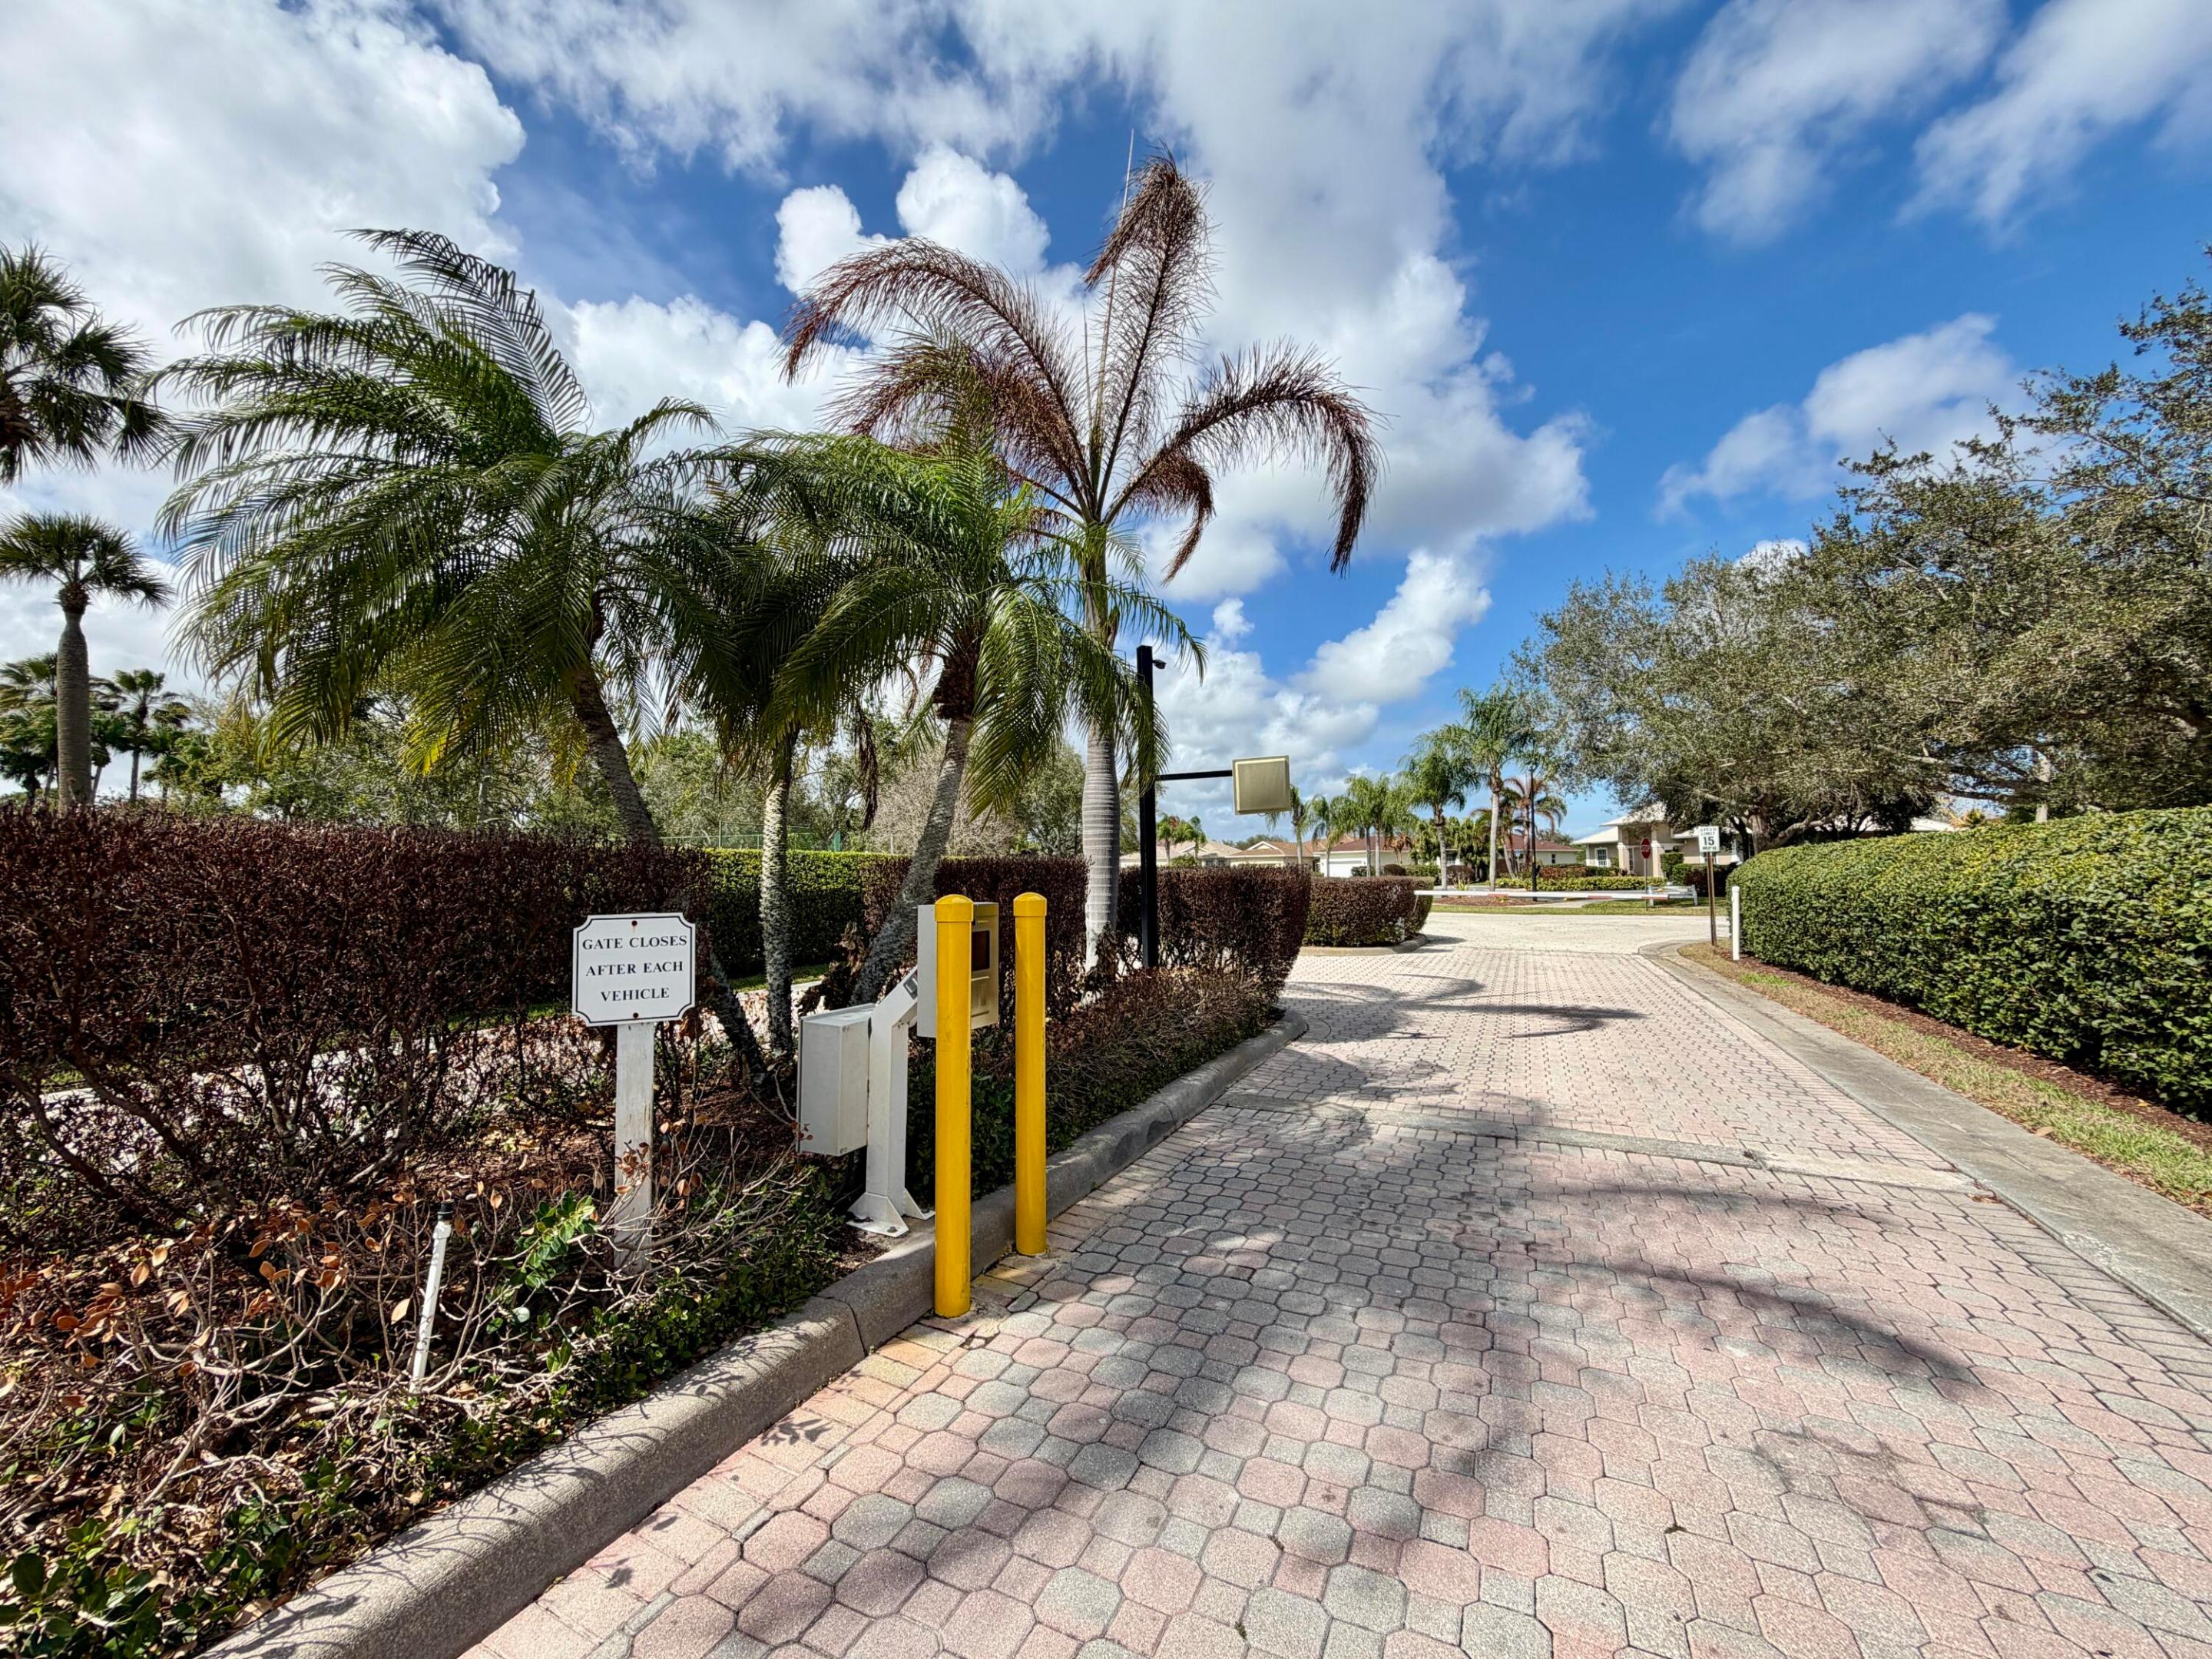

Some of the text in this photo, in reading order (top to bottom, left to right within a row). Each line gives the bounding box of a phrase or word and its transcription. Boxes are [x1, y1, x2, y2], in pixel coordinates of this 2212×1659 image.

[1703, 836, 1715, 846] 15
[582, 935, 687, 950] GATE CLOSES
[585, 961, 684, 976] AFTER EACH
[601, 987, 670, 1002] VEHICLE
